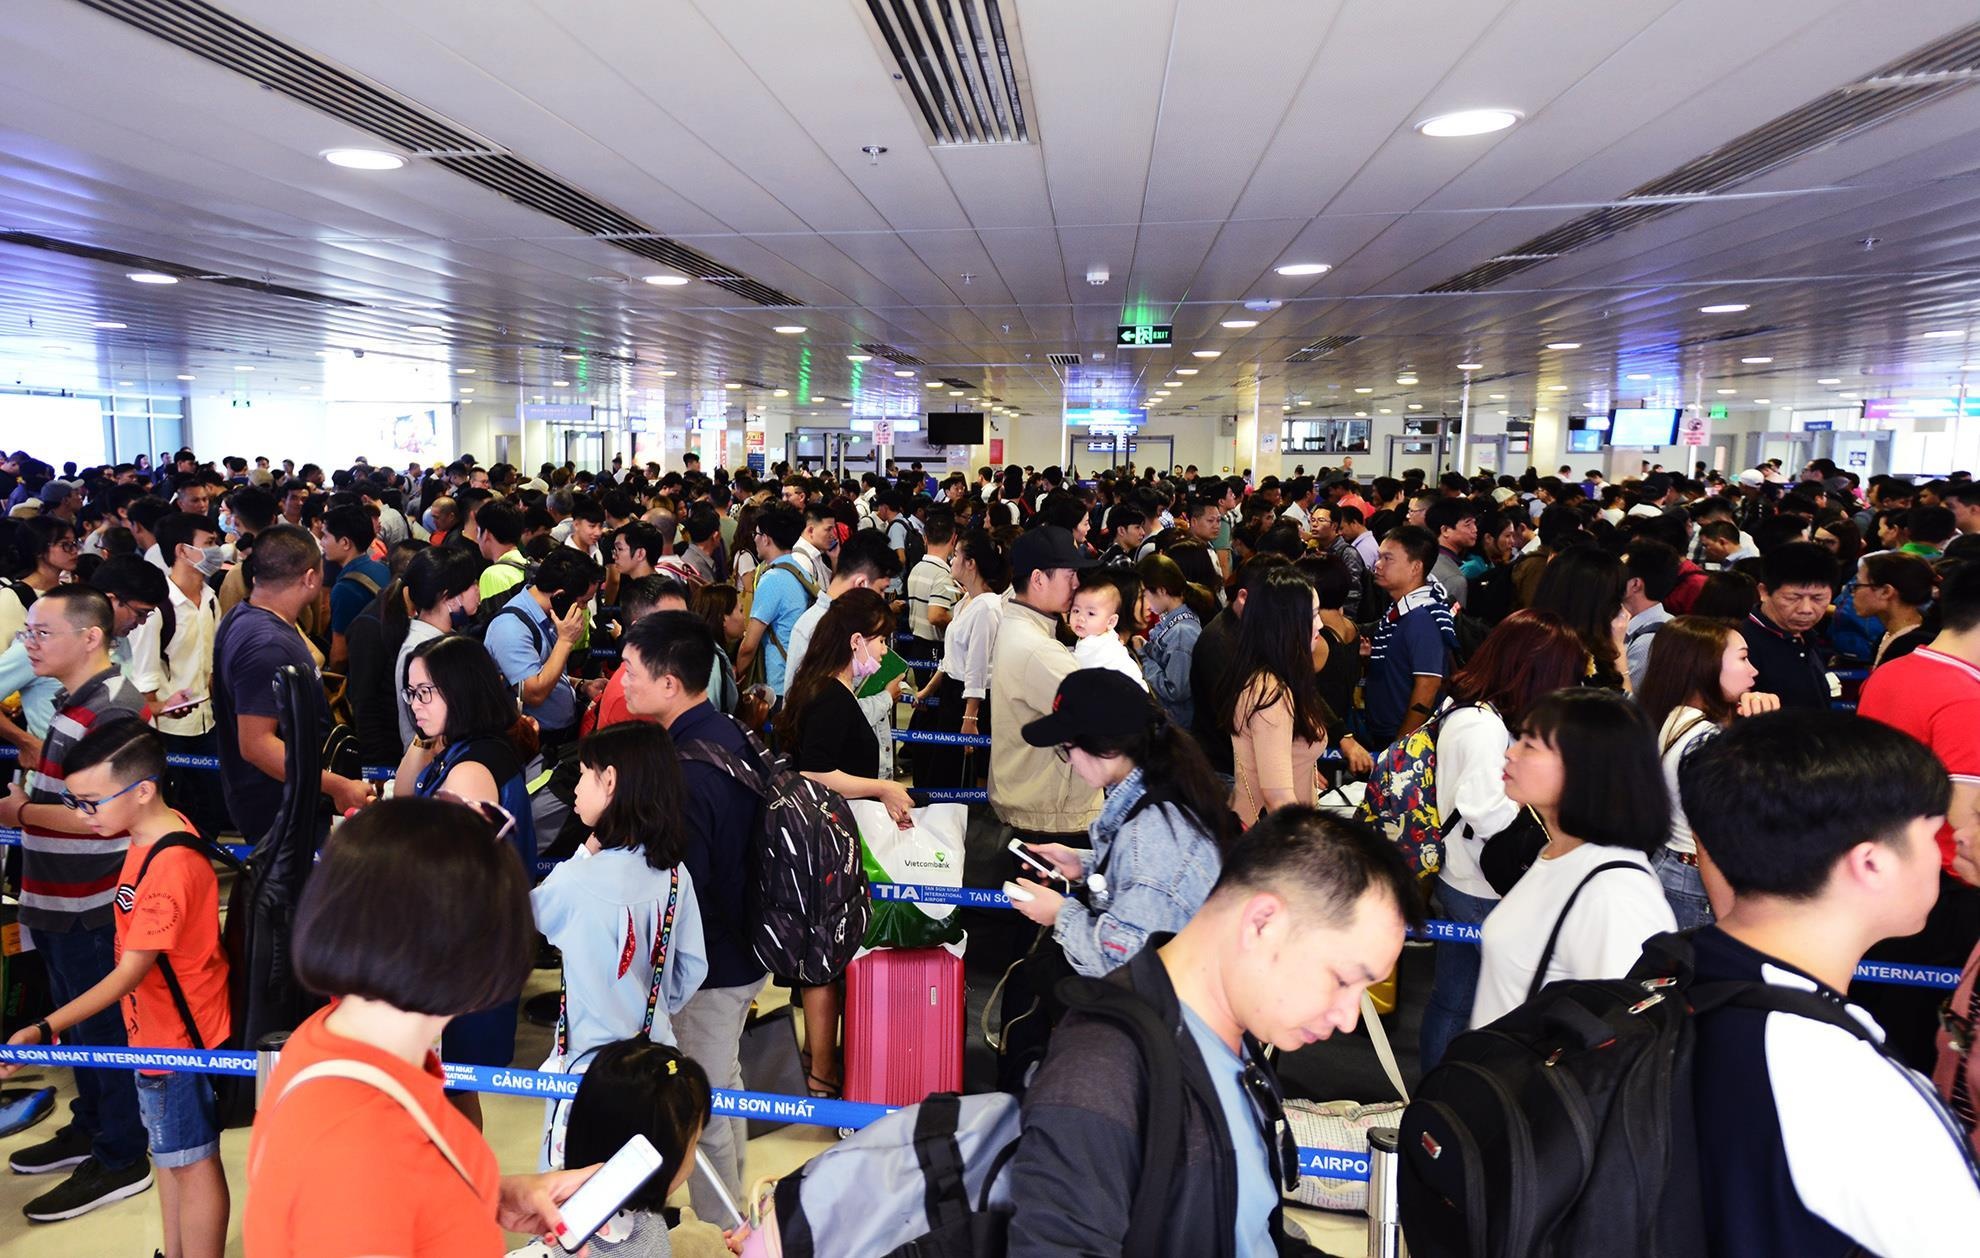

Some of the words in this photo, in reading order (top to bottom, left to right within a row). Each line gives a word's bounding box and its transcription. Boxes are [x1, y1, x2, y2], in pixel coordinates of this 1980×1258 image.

[1153, 331, 1169, 339] EXIT
[912, 731, 933, 740] CẢNG
[934, 733, 956, 742] HÀNG
[957, 735, 984, 744] KHÔNG
[191, 756, 213, 767] QUỐC
[904, 859, 950, 869] Vietcombank
[876, 884, 919, 900] TIA
[969, 892, 992, 902] TAN
[1437, 923, 1454, 936] TẾ
[17, 1050, 48, 1061] SON
[51, 1051, 90, 1063] NHAT
[93, 1052, 206, 1068] INTERNATIONAL
[492, 1071, 533, 1089] CẢNG
[536, 1075, 578, 1094] HÀNG
[738, 1098, 771, 1113] SƠN
[774, 1099, 815, 1117] NHẤT
